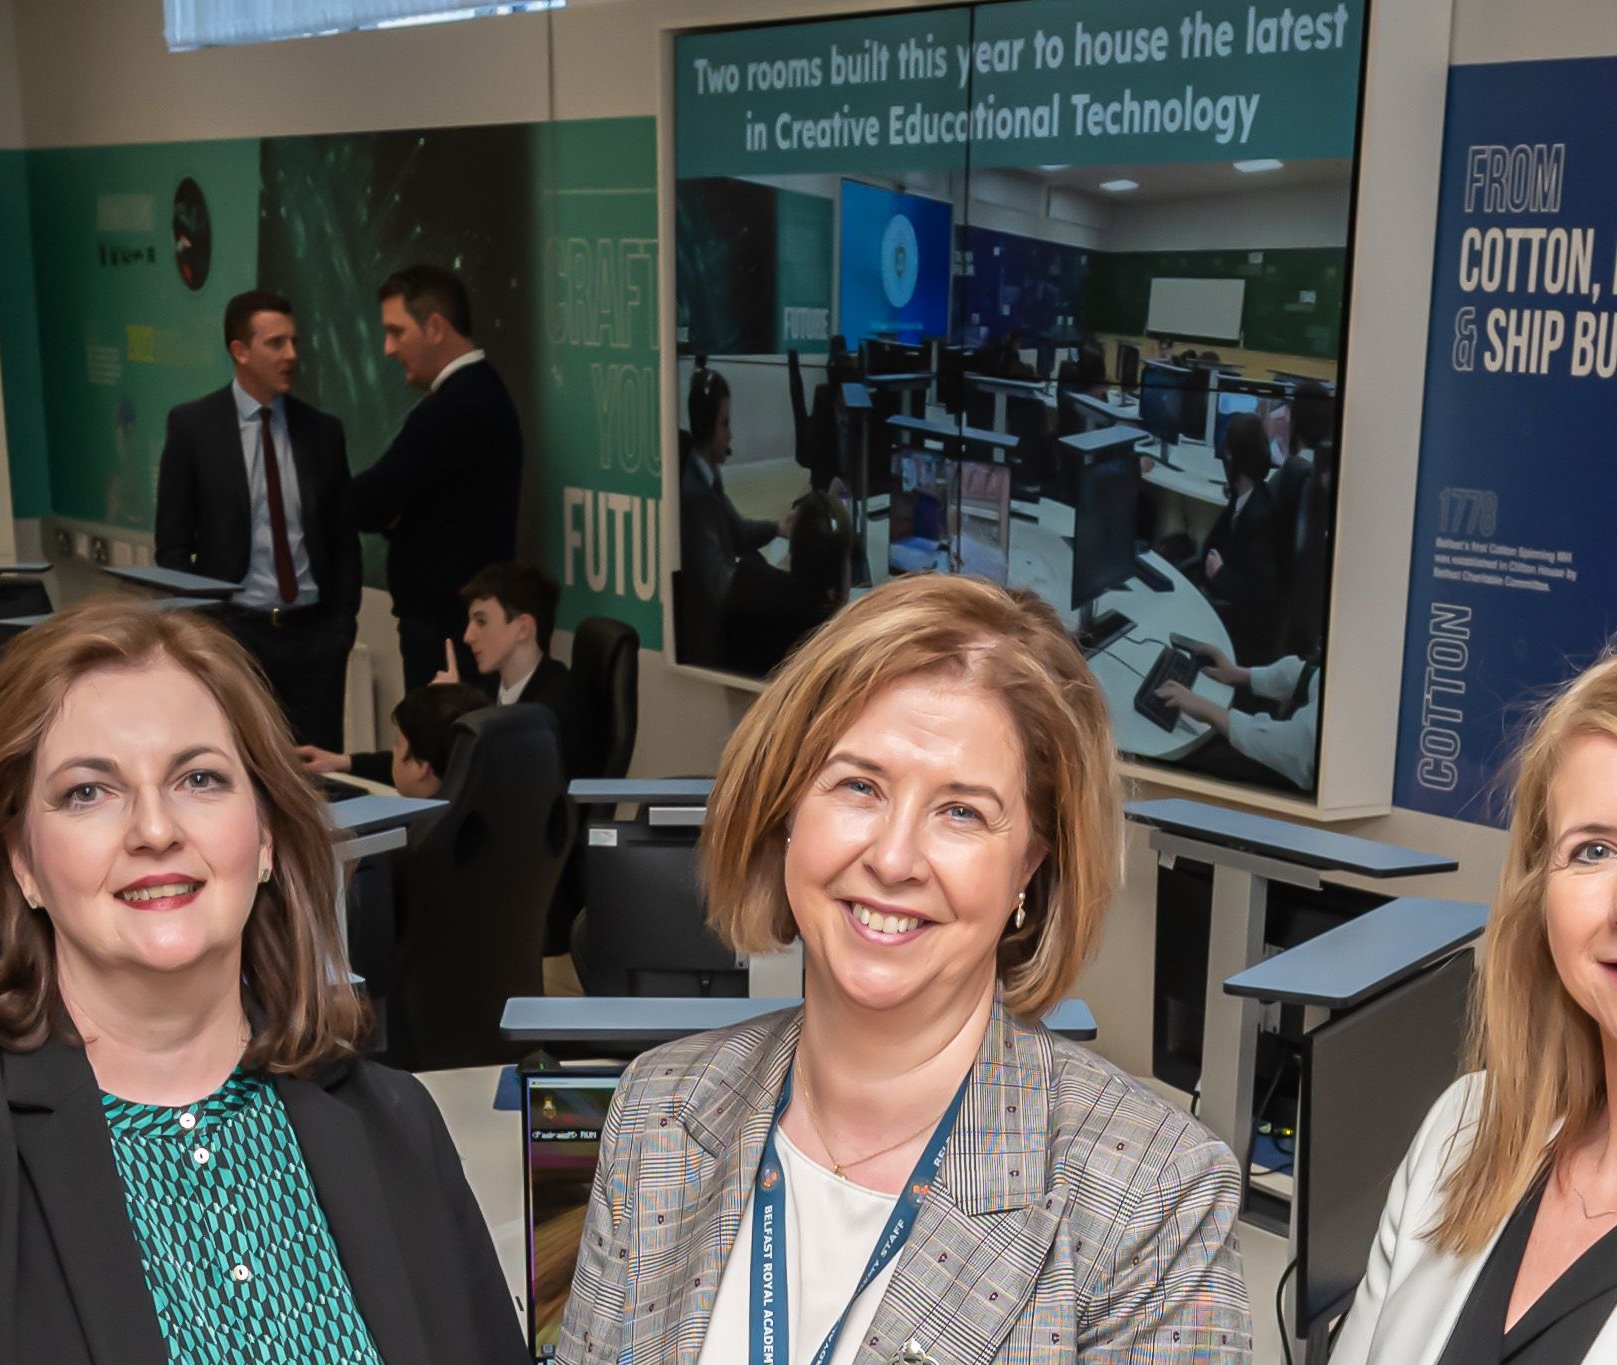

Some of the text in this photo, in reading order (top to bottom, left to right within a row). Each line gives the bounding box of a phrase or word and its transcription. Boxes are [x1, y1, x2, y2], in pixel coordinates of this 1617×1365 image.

[694, 3, 1348, 94] Two rooms built this year to house the latest
[746, 85, 1260, 151] in Creative Educational Technology
[1464, 144, 1565, 213] FROM
[1459, 227, 1600, 304] COTTON,
[1453, 306, 1477, 372] &
[1484, 308, 1564, 374] SHIP
[564, 486, 662, 602] FUTU
[1417, 602, 1472, 791] COTTON
[763, 1205, 773, 1259] BELFAST
[881, 1219, 905, 1257] STAFF
[763, 1263, 774, 1306] ROYAL
